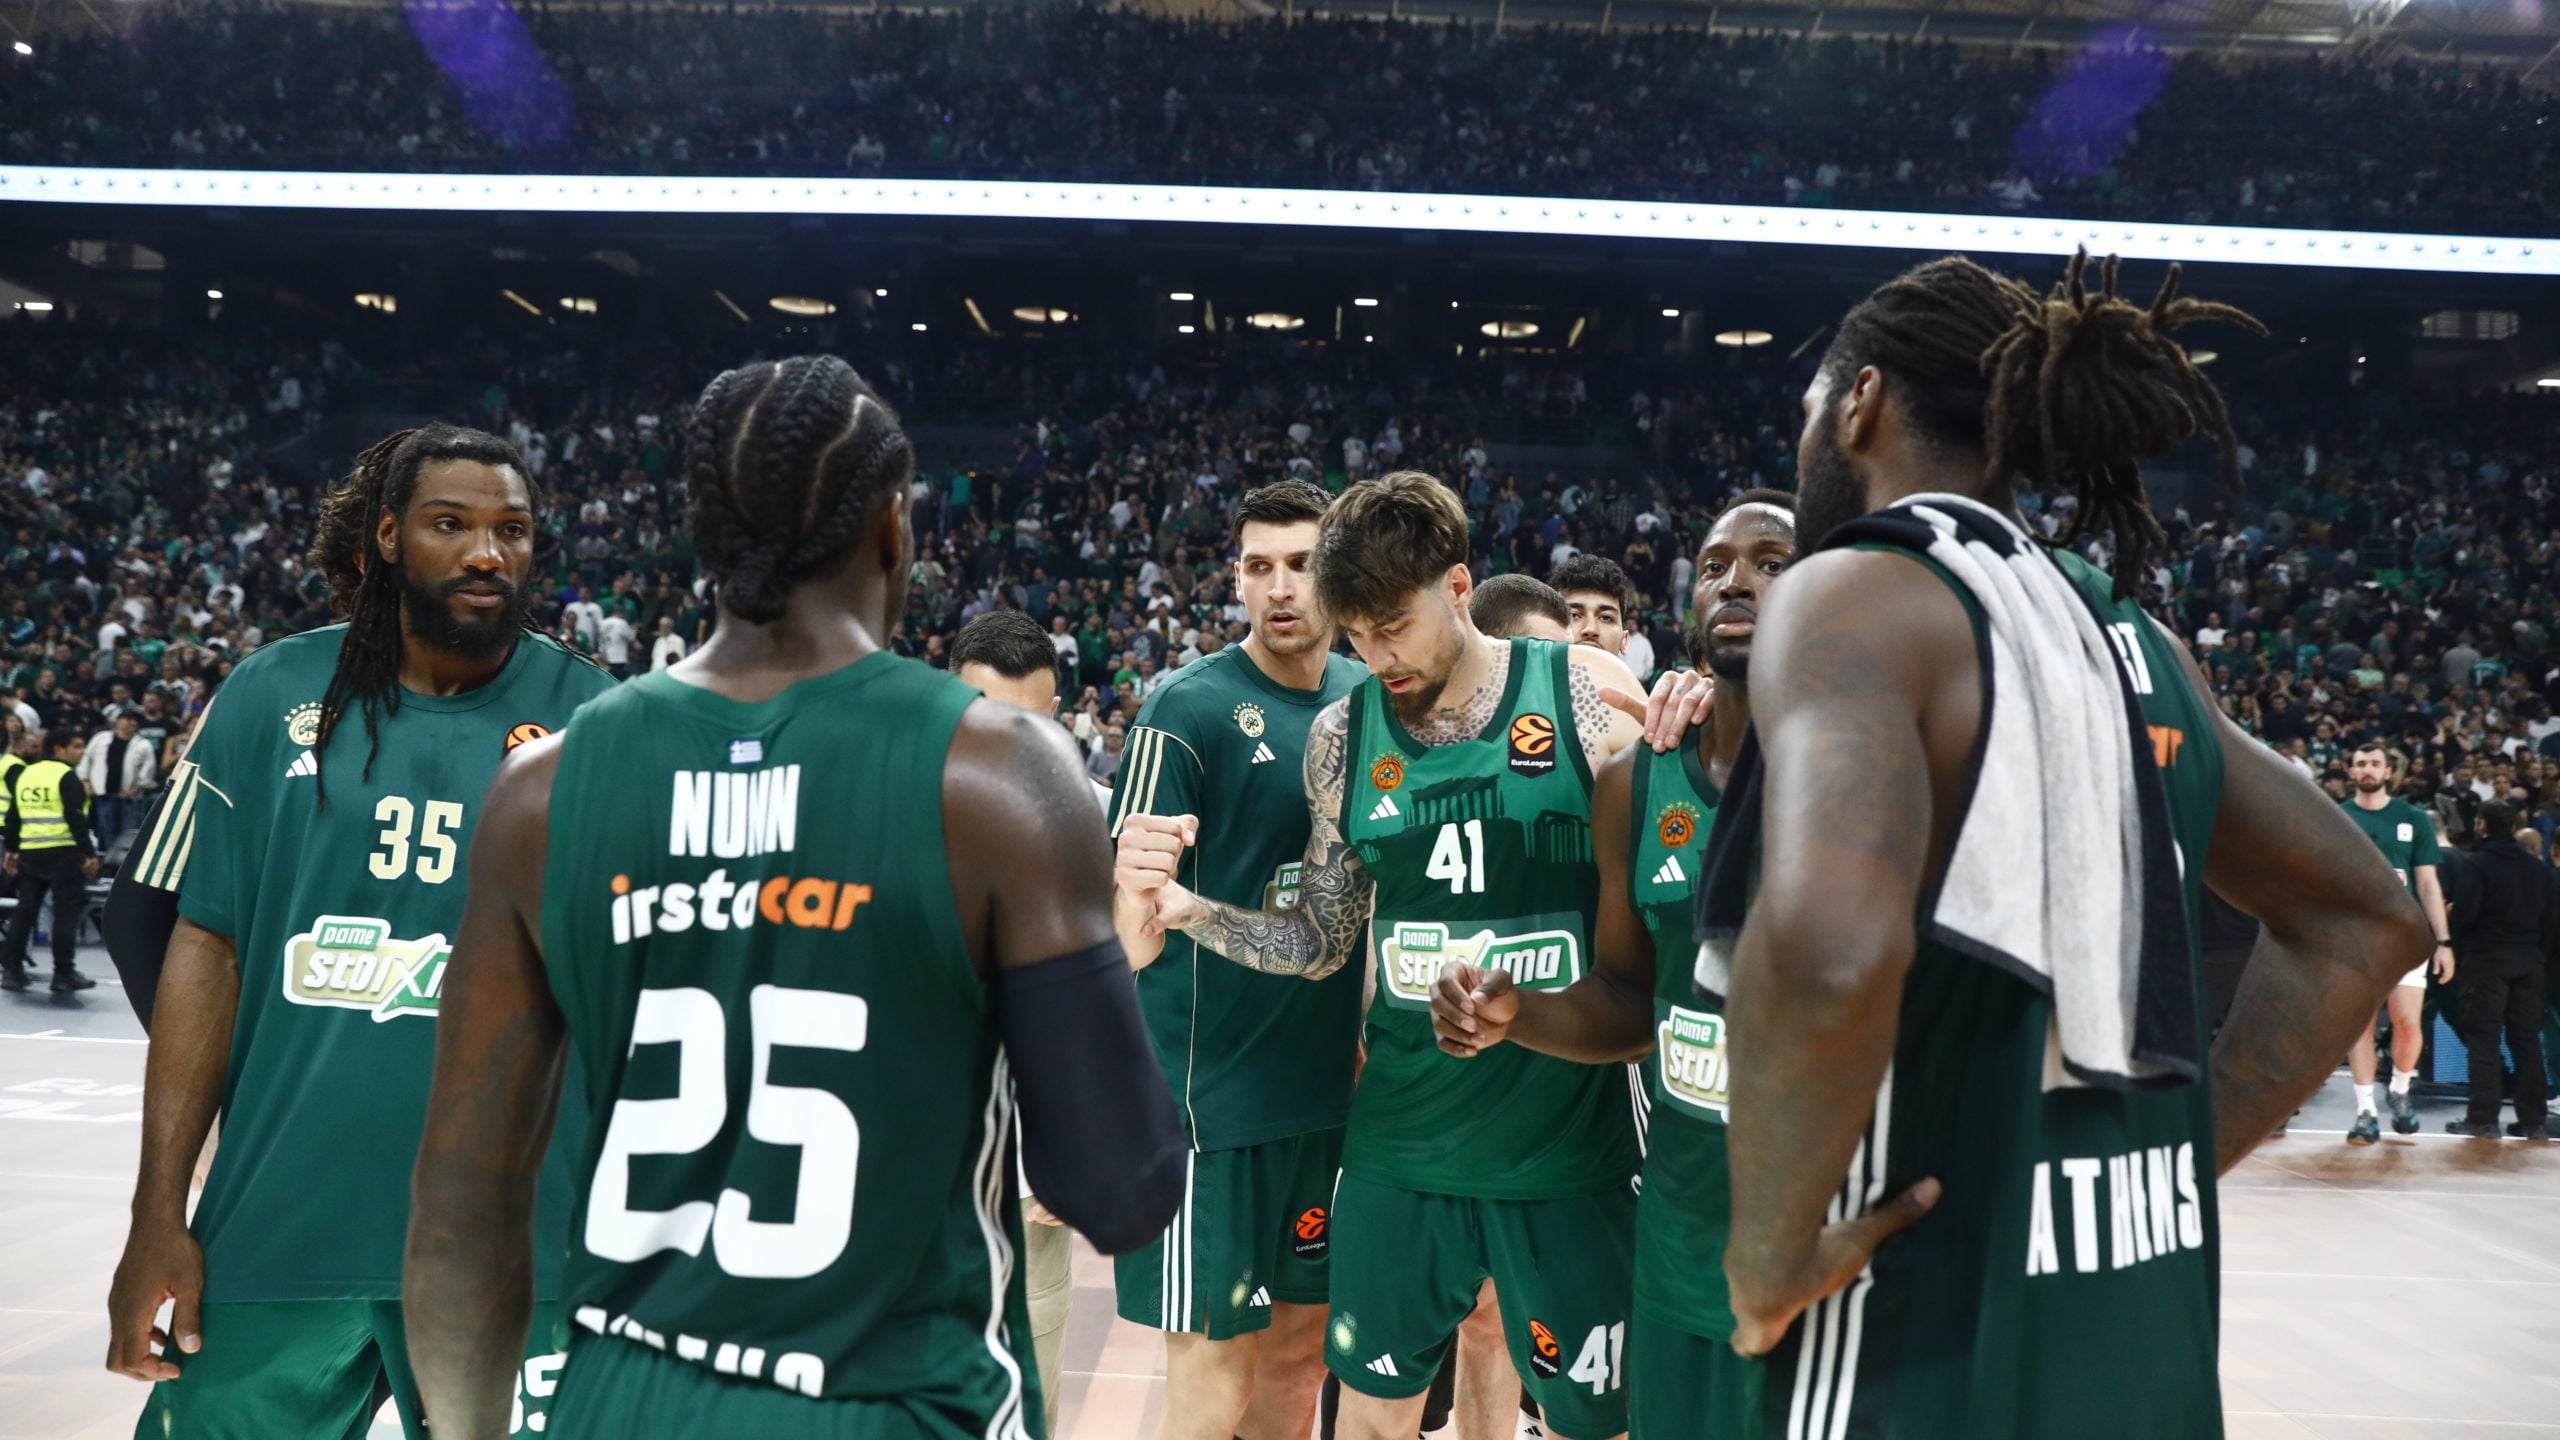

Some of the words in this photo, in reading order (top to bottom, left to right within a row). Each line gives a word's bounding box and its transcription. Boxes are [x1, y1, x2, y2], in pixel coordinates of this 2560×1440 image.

[1511, 759, 1553, 768] EuroLeague
[21, 787, 50, 802] CSI
[669, 764, 800, 859] NUNN
[369, 795, 464, 885] 35
[1425, 819, 1485, 895] 41
[321, 927, 376, 945] pame
[1403, 931, 1438, 947] pame
[1674, 1018, 1712, 1042] pame
[584, 983, 869, 1279] 25
[1295, 1242, 1326, 1252] EuroLeague
[1567, 1320, 1625, 1396] 41
